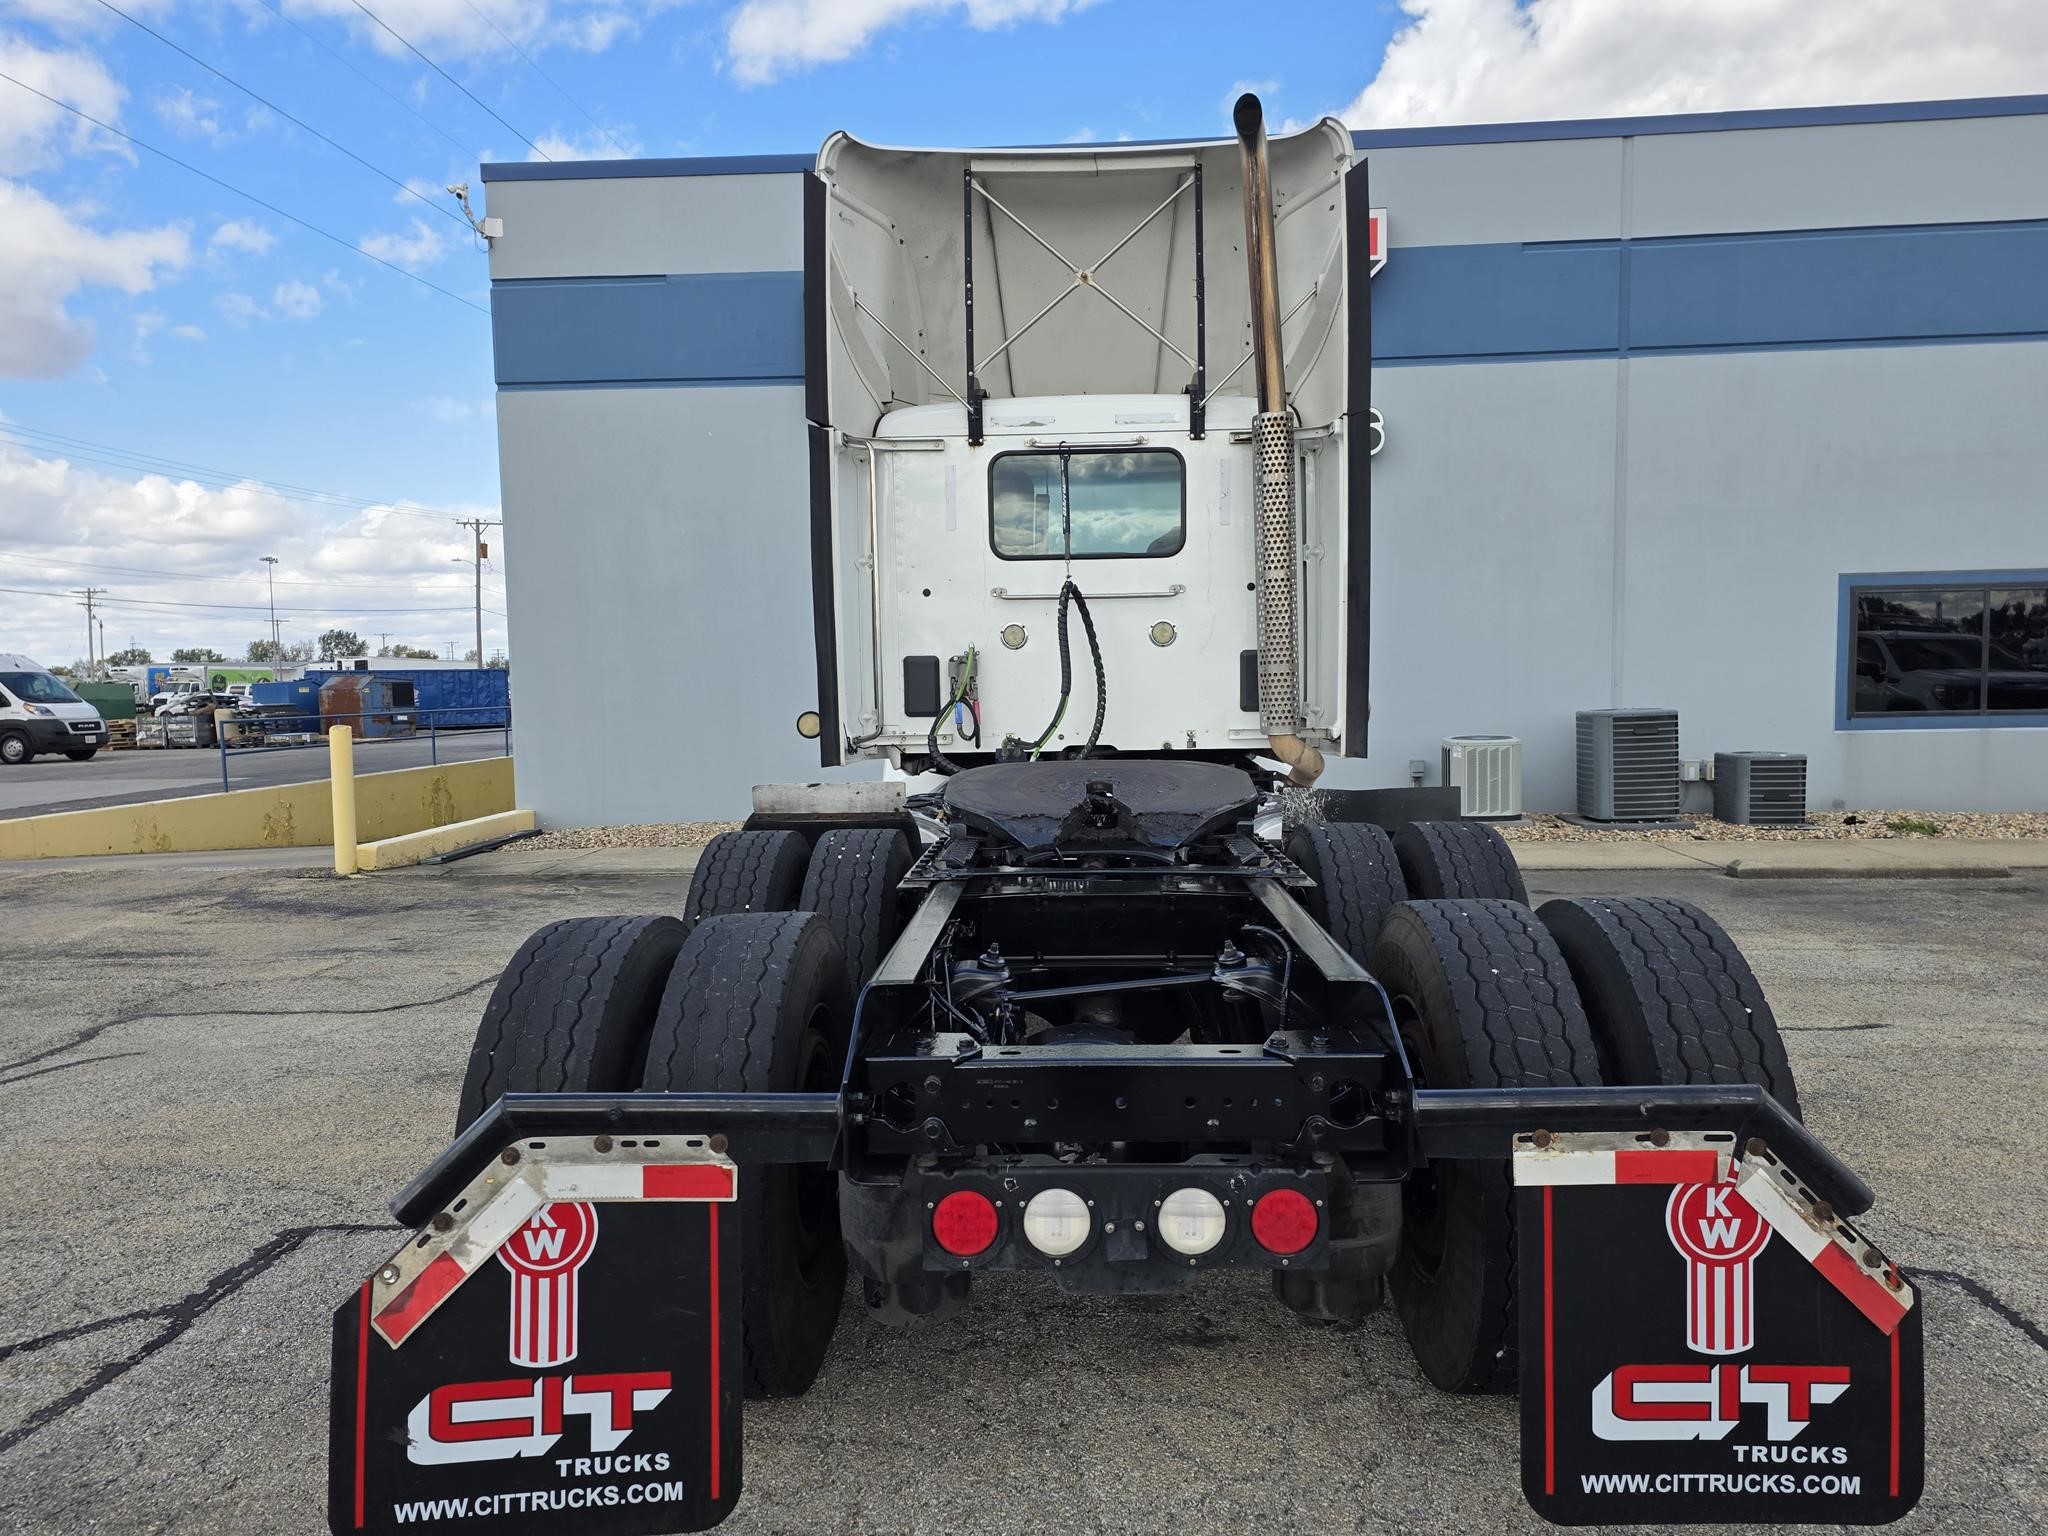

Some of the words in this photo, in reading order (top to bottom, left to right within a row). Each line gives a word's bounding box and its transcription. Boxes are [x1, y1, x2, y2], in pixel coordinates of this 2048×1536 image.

[530, 1201, 558, 1229] K
[1705, 1186, 1734, 1218] K
[523, 1229, 567, 1261] W
[1698, 1218, 1742, 1249] W
[1592, 1364, 1851, 1441] CIT
[408, 1371, 672, 1466] CIT
[555, 1452, 671, 1477] TRUCKS
[1733, 1445, 1848, 1464] TRUCKS
[1581, 1474, 1861, 1496] WWW.CITTRUCKS.COM
[393, 1481, 684, 1524] WWW.CITTRUCKS.COM
